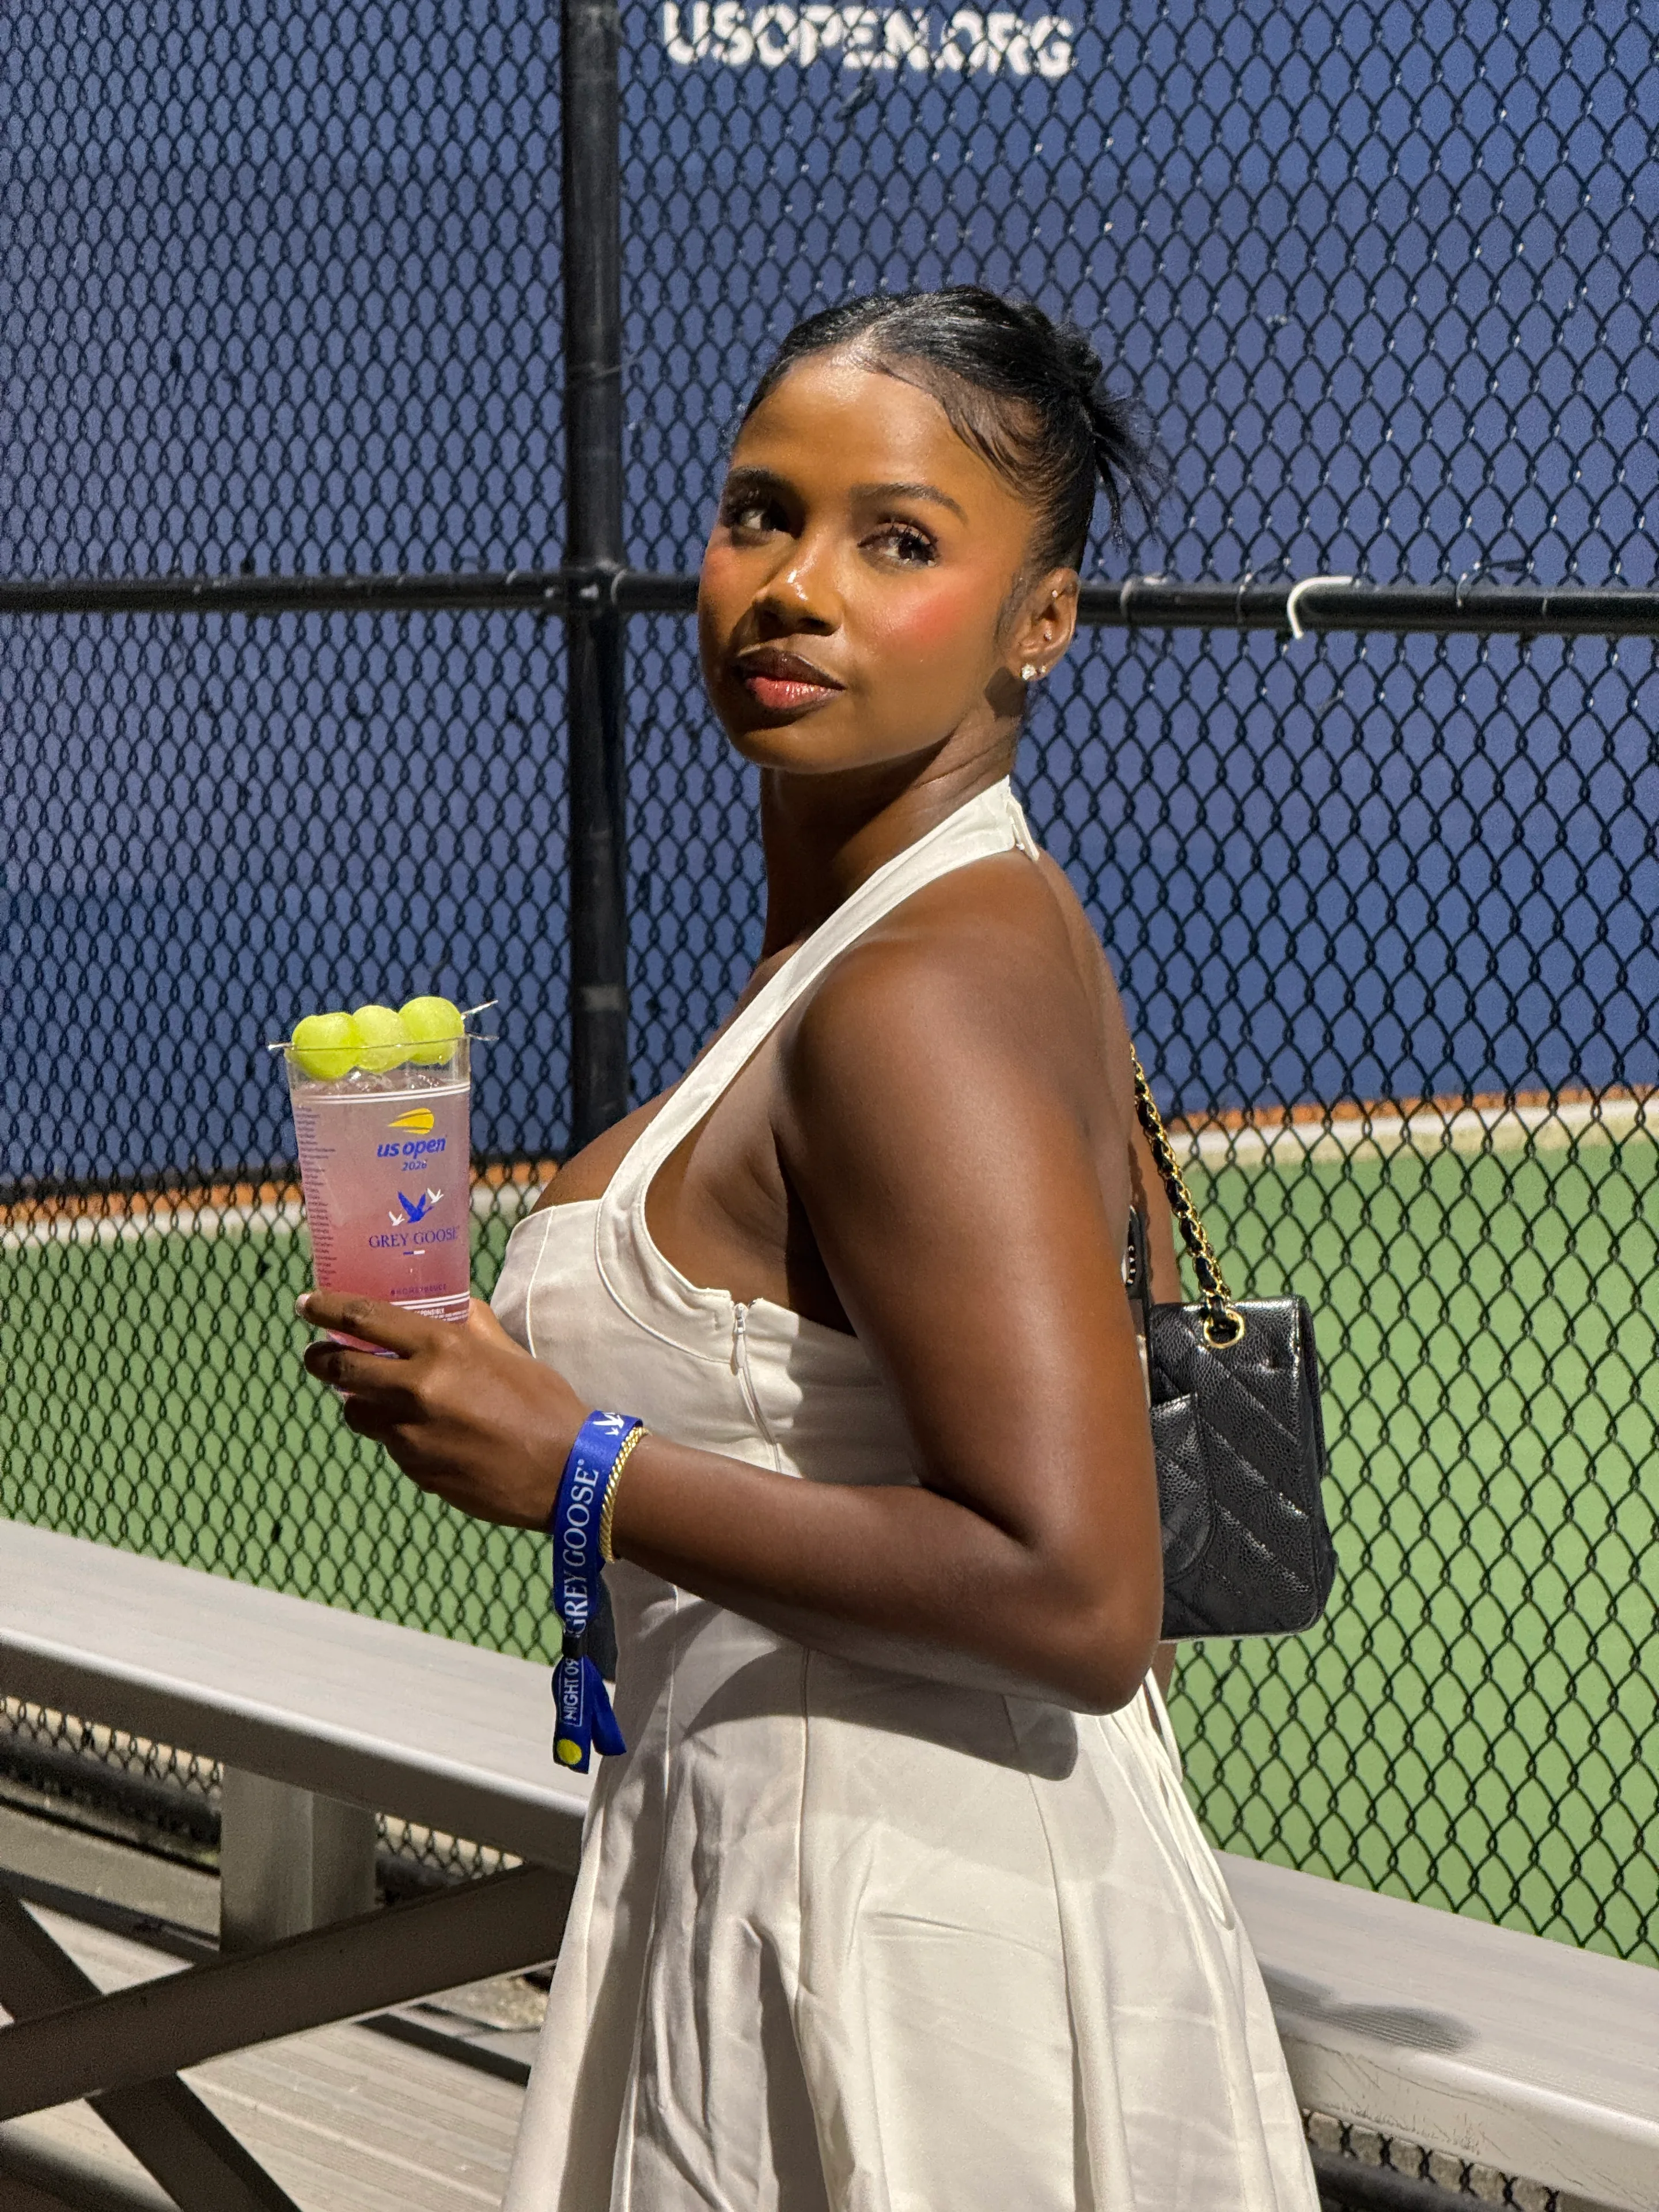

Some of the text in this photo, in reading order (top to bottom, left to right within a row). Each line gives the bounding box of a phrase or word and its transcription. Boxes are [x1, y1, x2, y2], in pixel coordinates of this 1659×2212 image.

[662, 1, 1073, 77] USOPEN.ORG
[377, 1138, 446, 1159] us open
[369, 1228, 458, 1248] GREY GOOSE
[562, 1466, 599, 1638] GREY GOOSE
[563, 1677, 579, 1721] NIGHT
